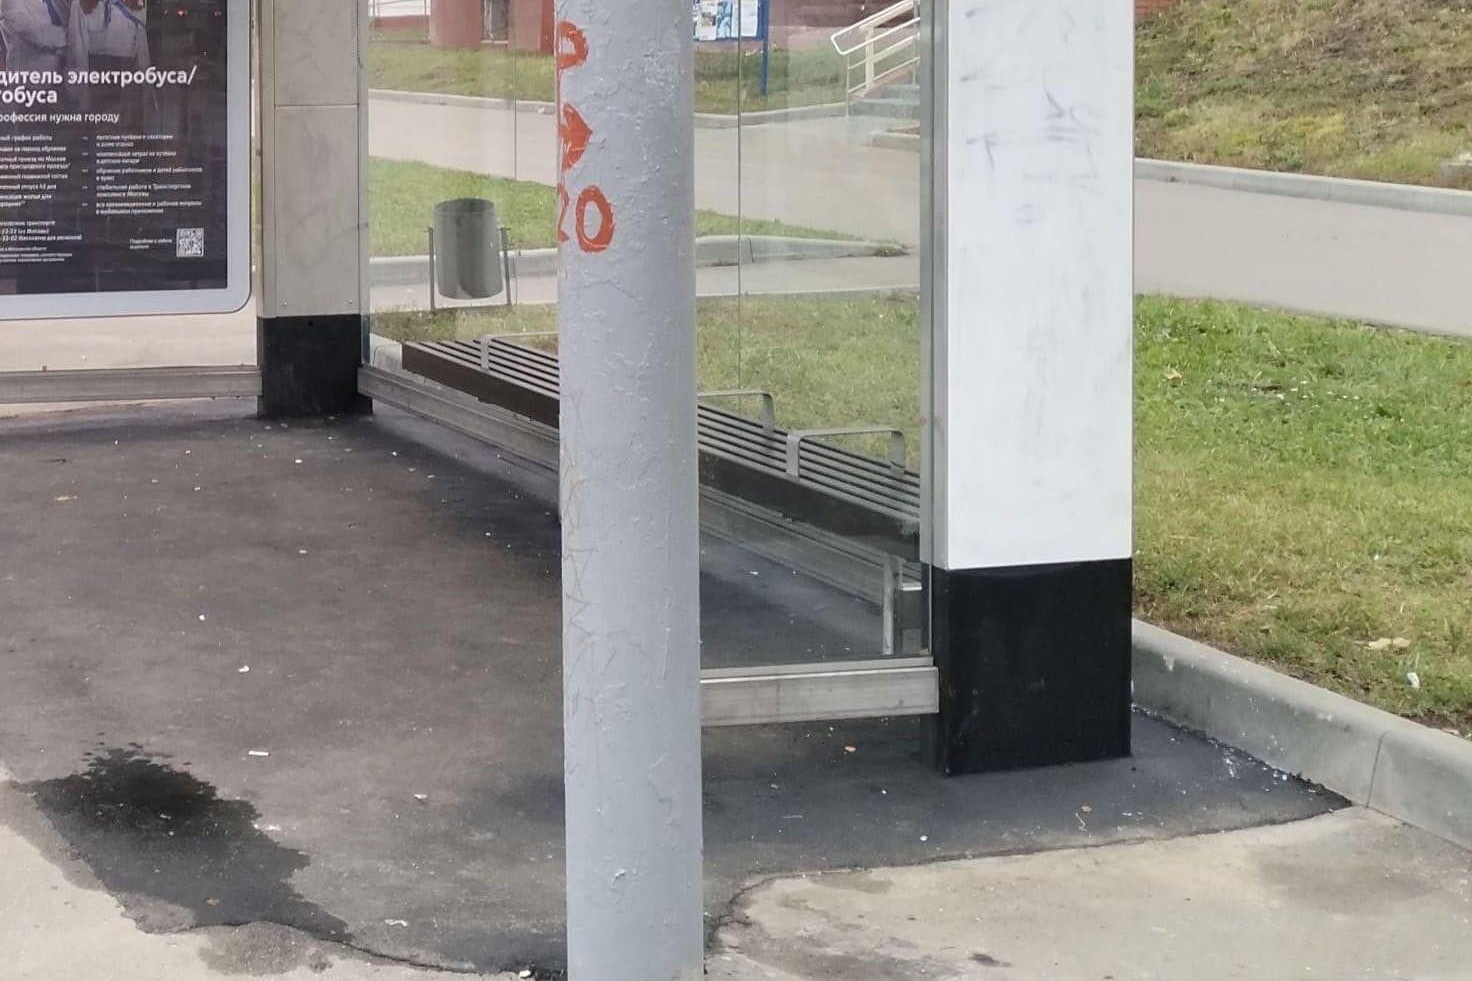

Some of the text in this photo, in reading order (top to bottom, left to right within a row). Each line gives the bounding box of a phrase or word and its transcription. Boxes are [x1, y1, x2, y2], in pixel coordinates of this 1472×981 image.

[67, 66, 197, 88] электробуса/
[50, 113, 82, 123] нужна
[84, 113, 120, 124] городу
